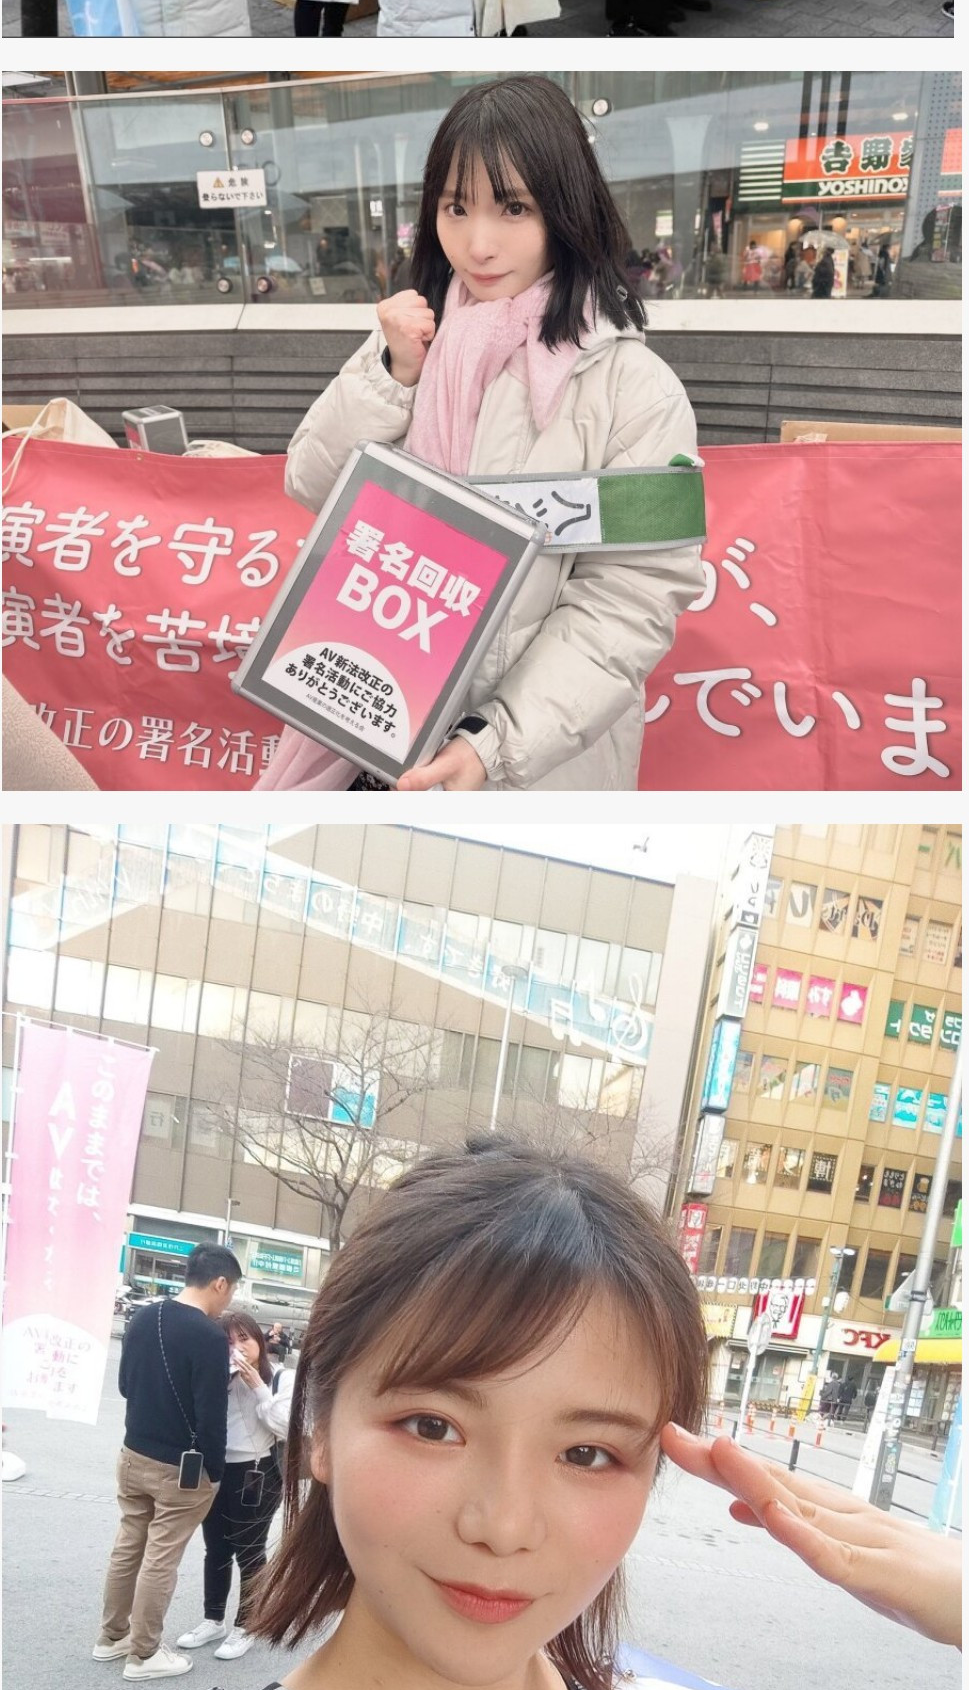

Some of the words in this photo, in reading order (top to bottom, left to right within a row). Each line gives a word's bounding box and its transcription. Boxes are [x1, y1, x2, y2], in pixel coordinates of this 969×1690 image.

[346, 520, 481, 617] 署名回収
[336, 563, 448, 654] BOX
[285, 662, 397, 739] ありがとうございます。
[302, 654, 398, 716] 署名活動にご協力
[320, 647, 394, 697] AV新法改正の
